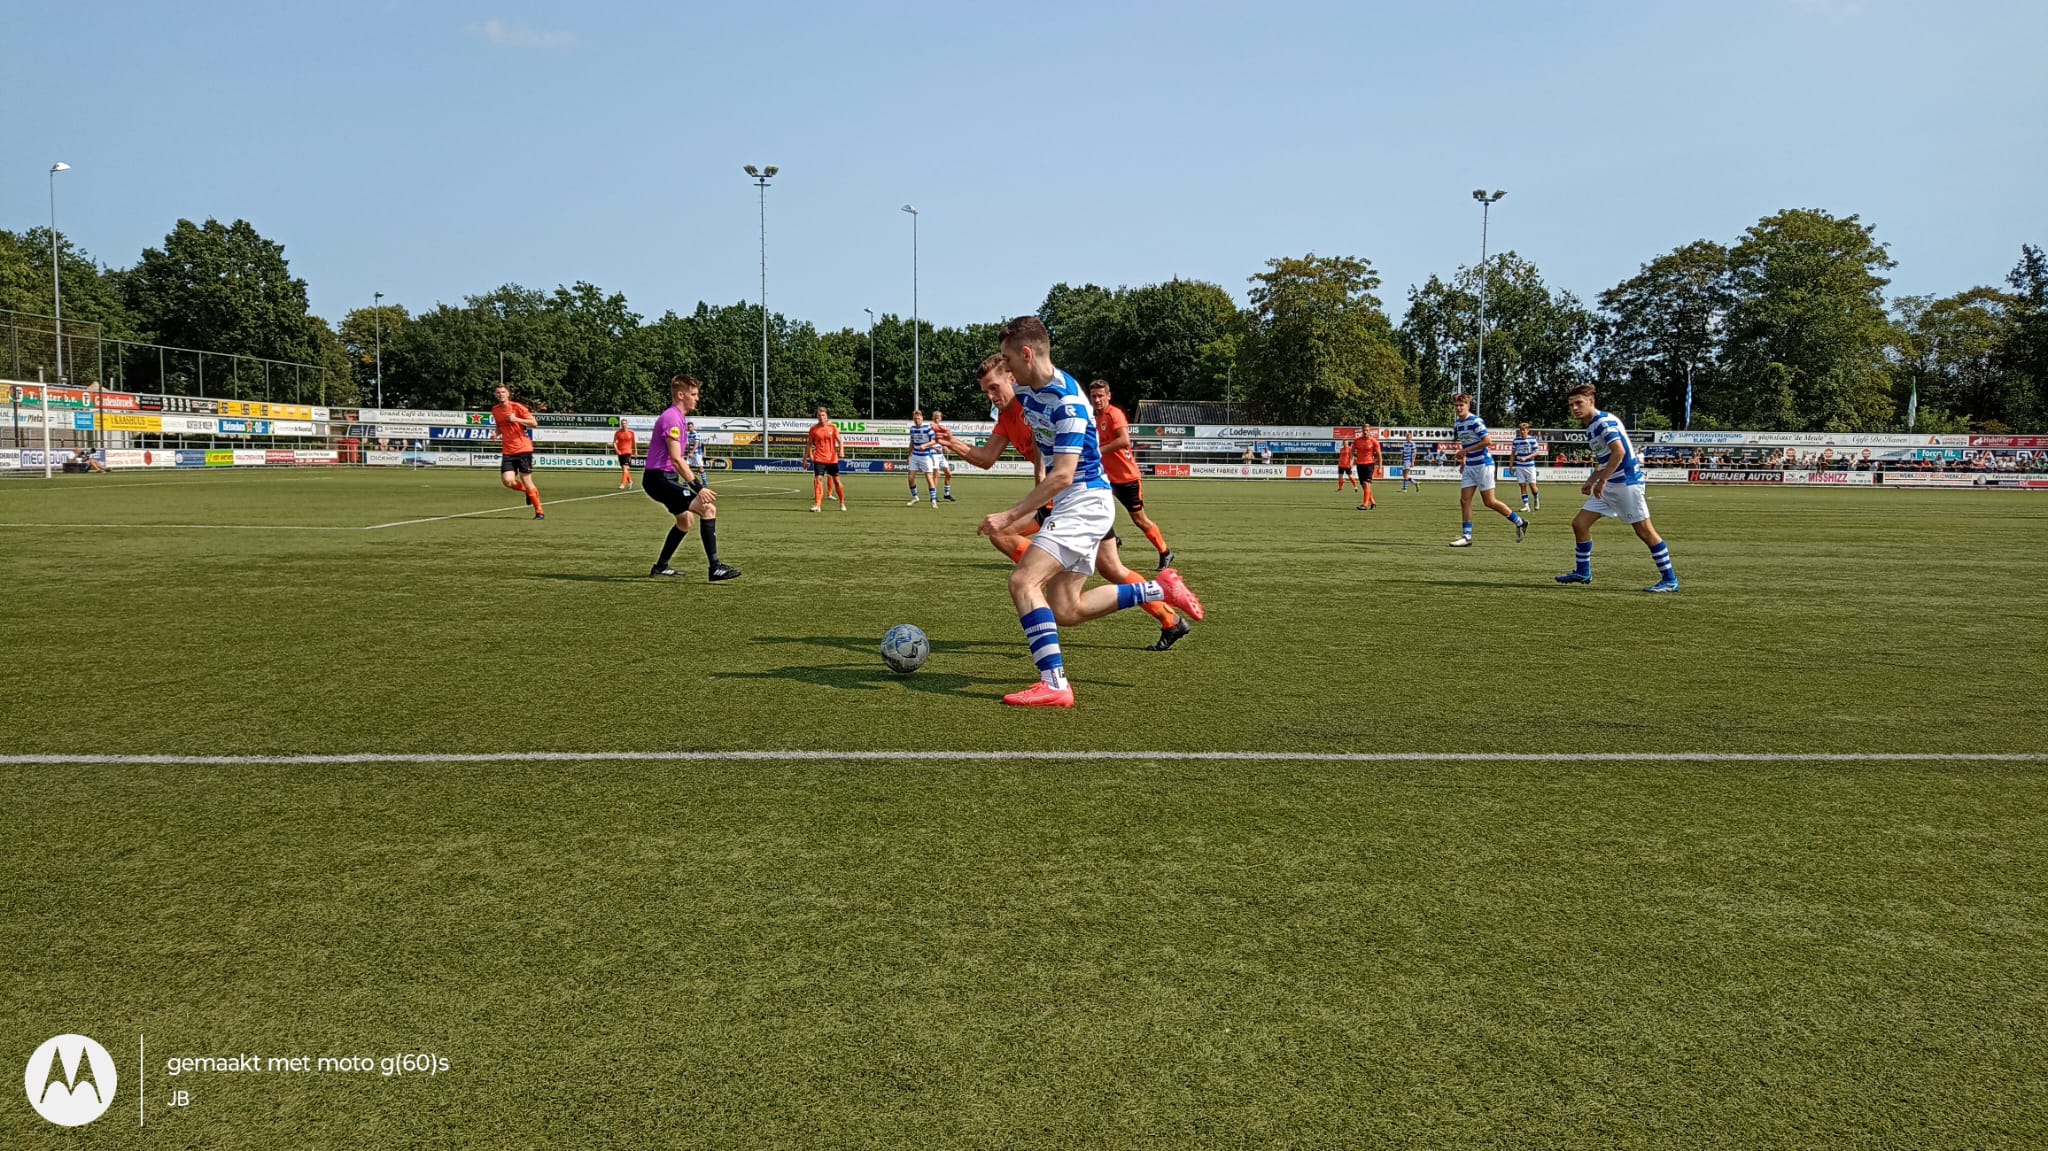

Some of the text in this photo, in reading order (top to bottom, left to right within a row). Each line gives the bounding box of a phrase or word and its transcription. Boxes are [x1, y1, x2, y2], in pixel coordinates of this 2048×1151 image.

[438, 428, 466, 438] JAN
[1229, 428, 1261, 438] Lodewijk
[540, 456, 605, 466] Business Club
[1690, 471, 1746, 481] HOFMEIJER
[1808, 472, 1848, 483] MISSHIZZ
